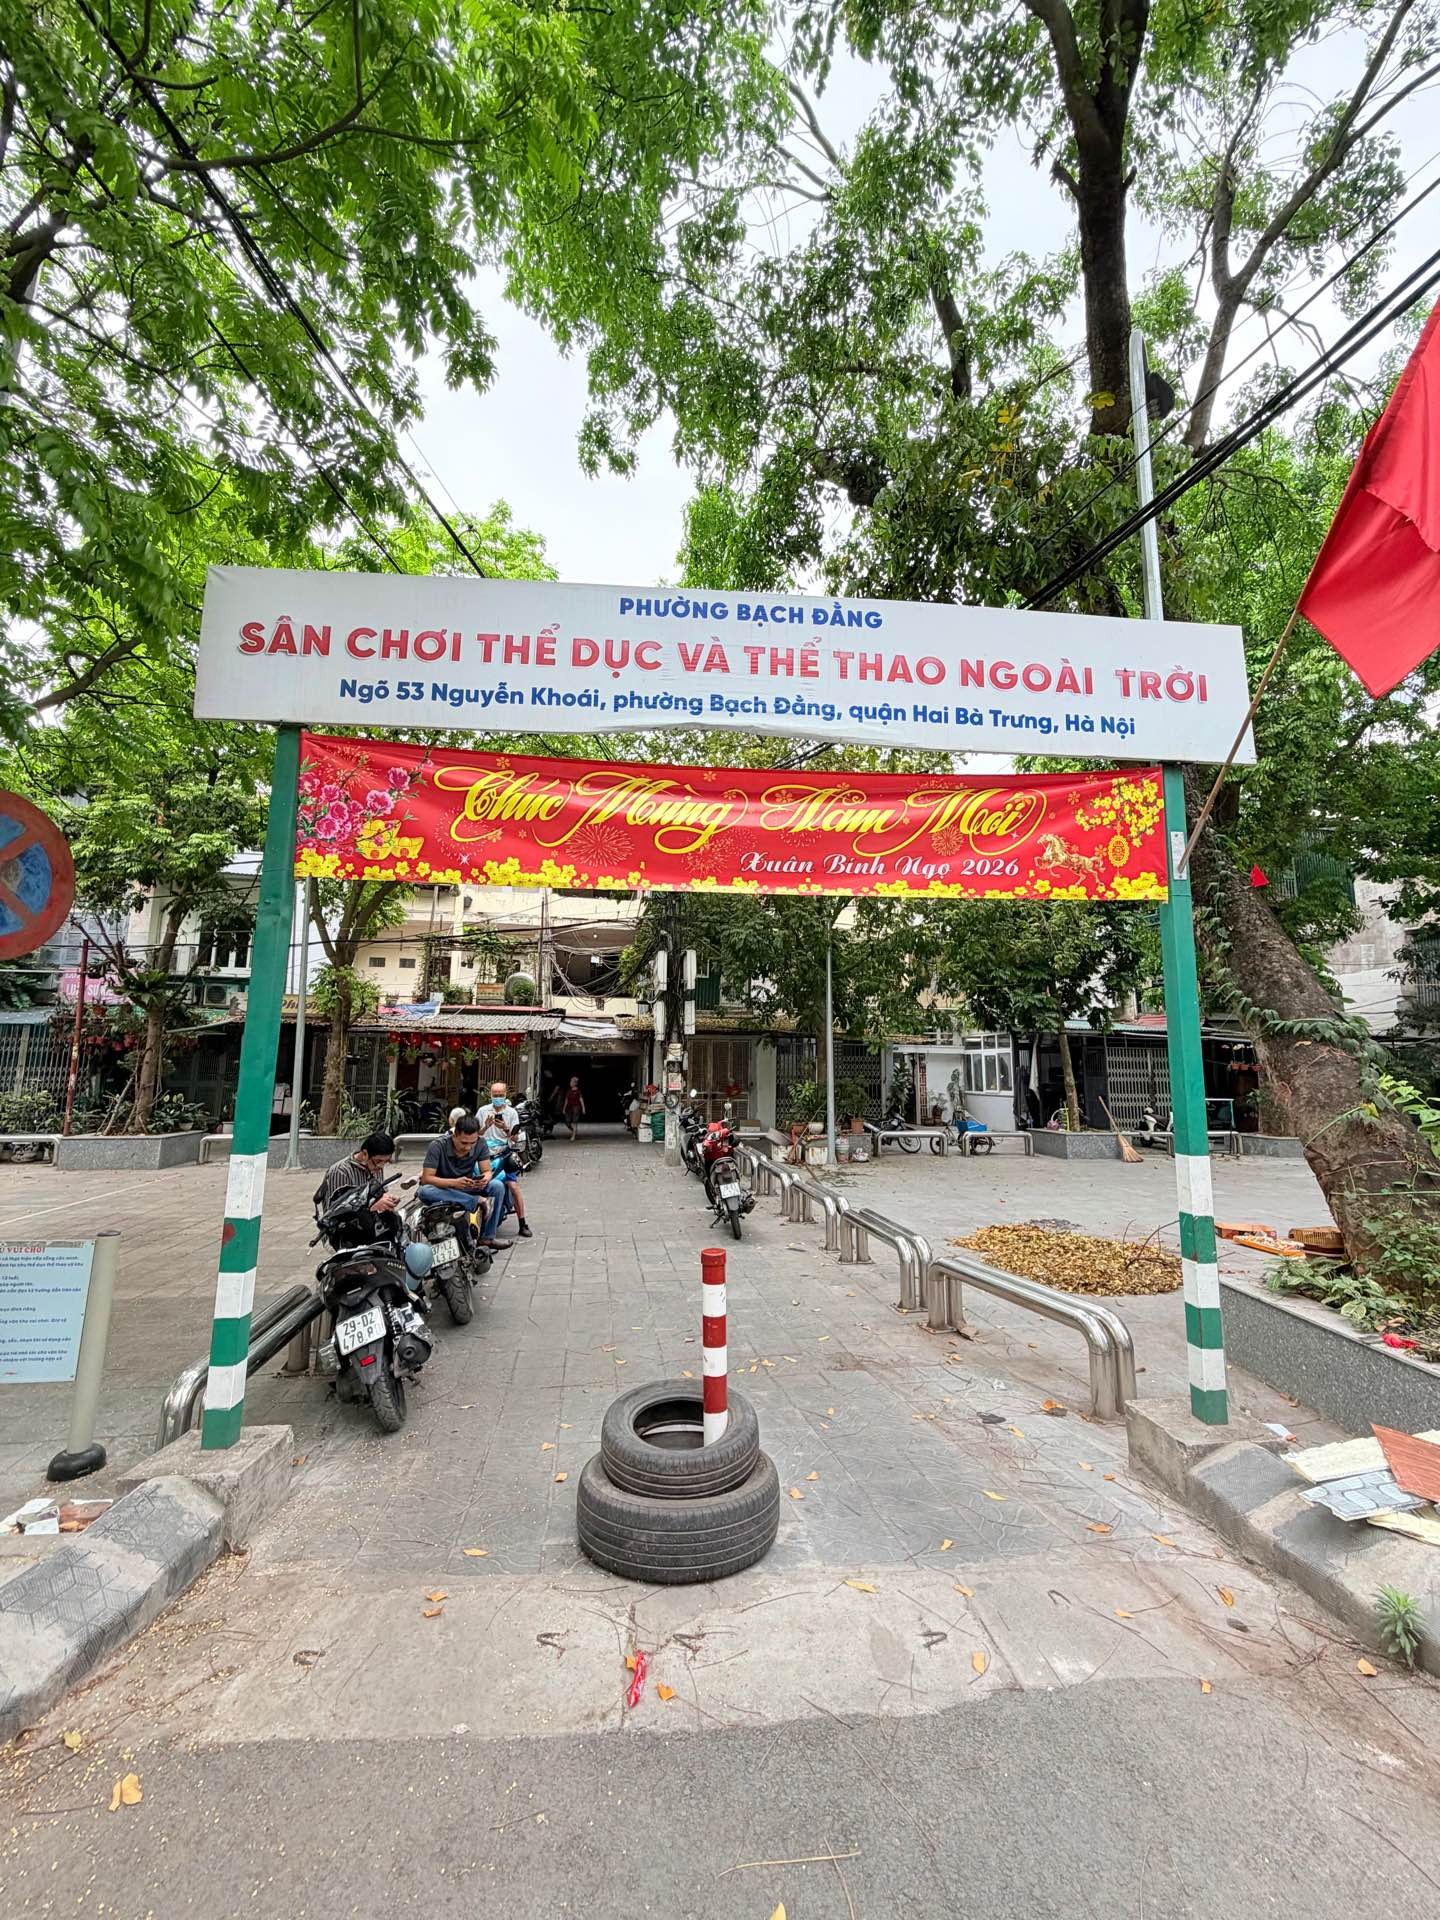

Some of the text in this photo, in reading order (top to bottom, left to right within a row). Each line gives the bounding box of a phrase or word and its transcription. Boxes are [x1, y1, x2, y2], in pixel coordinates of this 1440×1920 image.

[619, 596, 884, 630] PHƯỜNG BẠCH ĐẰNG
[239, 615, 1209, 703] SÂN CHƠI THỂ DỤC VÀ THỂ THAO NGOÀI TRỜI
[339, 678, 1137, 739] Ngõ 53 Nguyễn Khoái, phường Bạch Đằng, quận Hai Bà Trưng, Hà Nội
[434, 766, 573, 842] Chúc
[532, 771, 749, 854] Mừng
[740, 851, 814, 874] Xuân
[894, 856, 952, 880] Ngọ
[960, 858, 1019, 876] 2026
[343, 1311, 375, 1336] 29-D2
